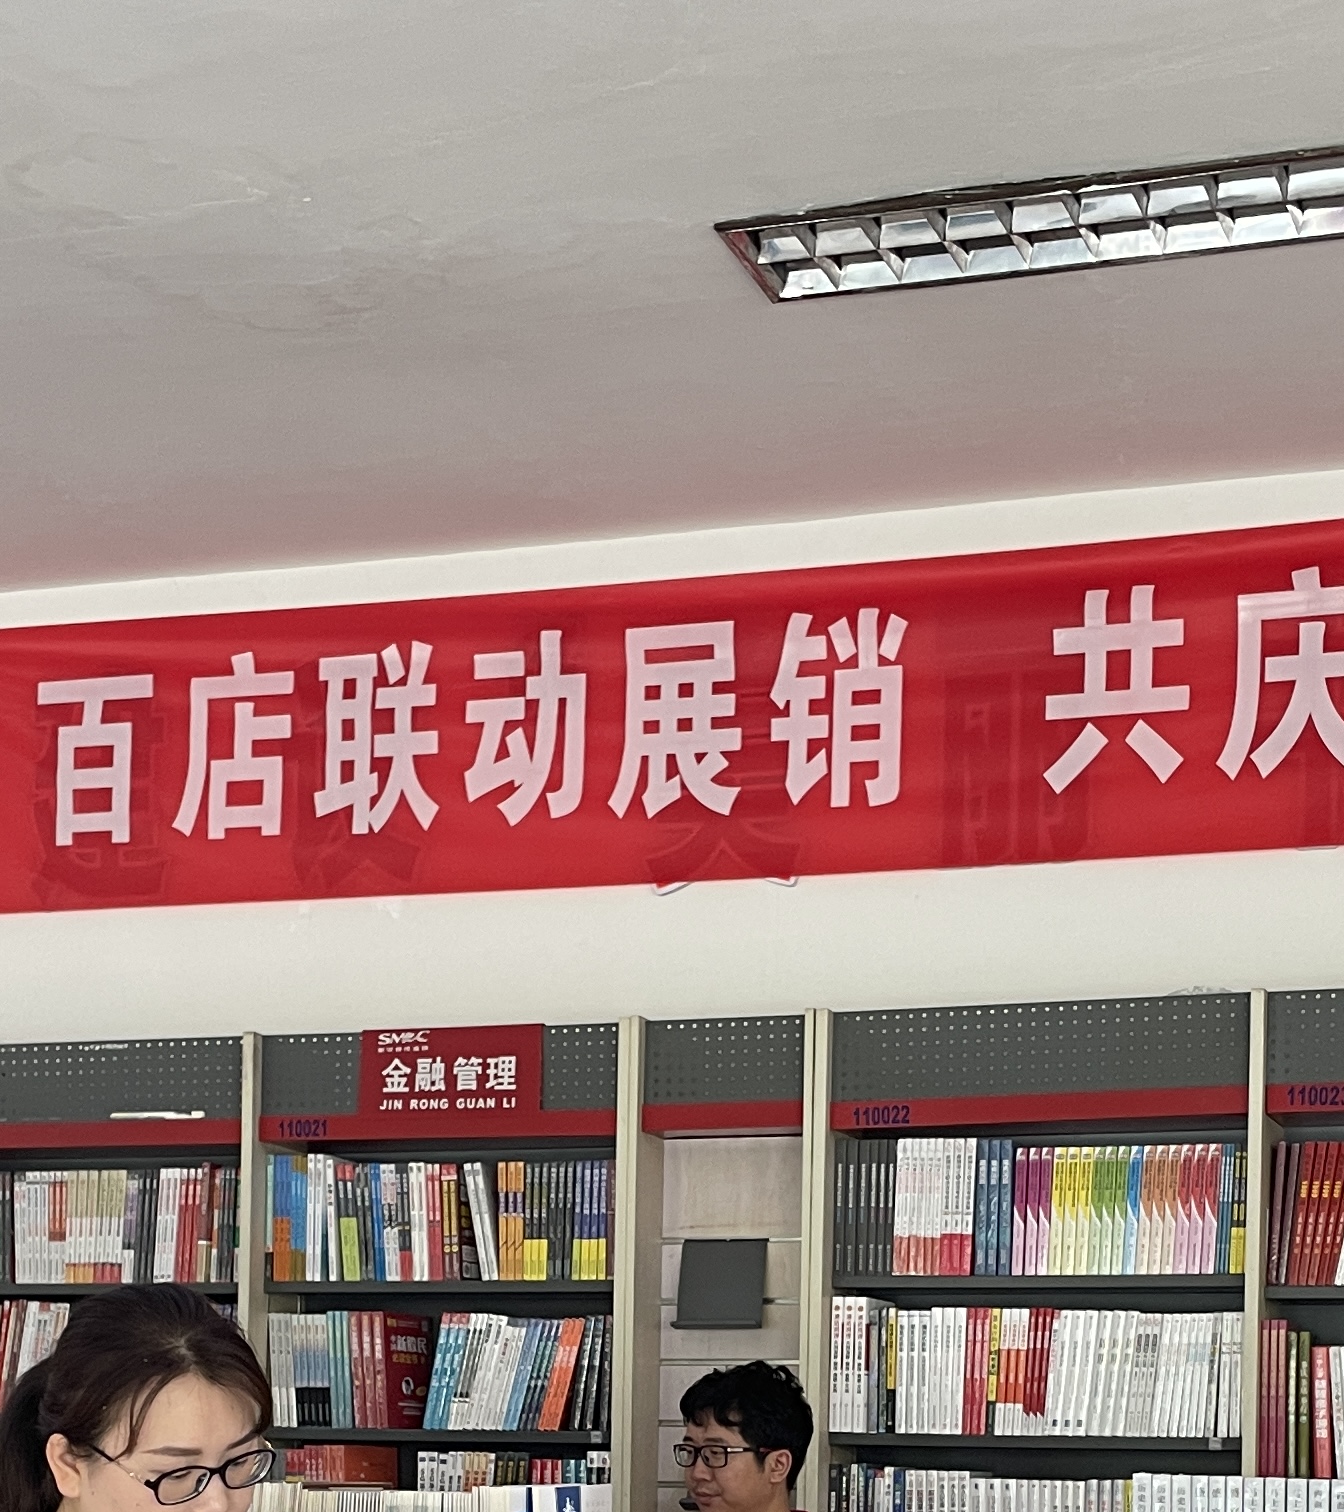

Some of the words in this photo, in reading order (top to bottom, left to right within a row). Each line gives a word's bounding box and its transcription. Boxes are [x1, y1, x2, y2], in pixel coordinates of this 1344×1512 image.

[37, 608, 908, 847] 百店联动展销
[381, 1055, 517, 1093] 金融管理
[379, 1099, 403, 1110] JIN
[409, 1098, 449, 1110] RONG
[455, 1097, 496, 1109] GUAN
[502, 1097, 516, 1108] LI
[852, 1103, 912, 1128] 110022
[279, 1119, 328, 1138] 110021
